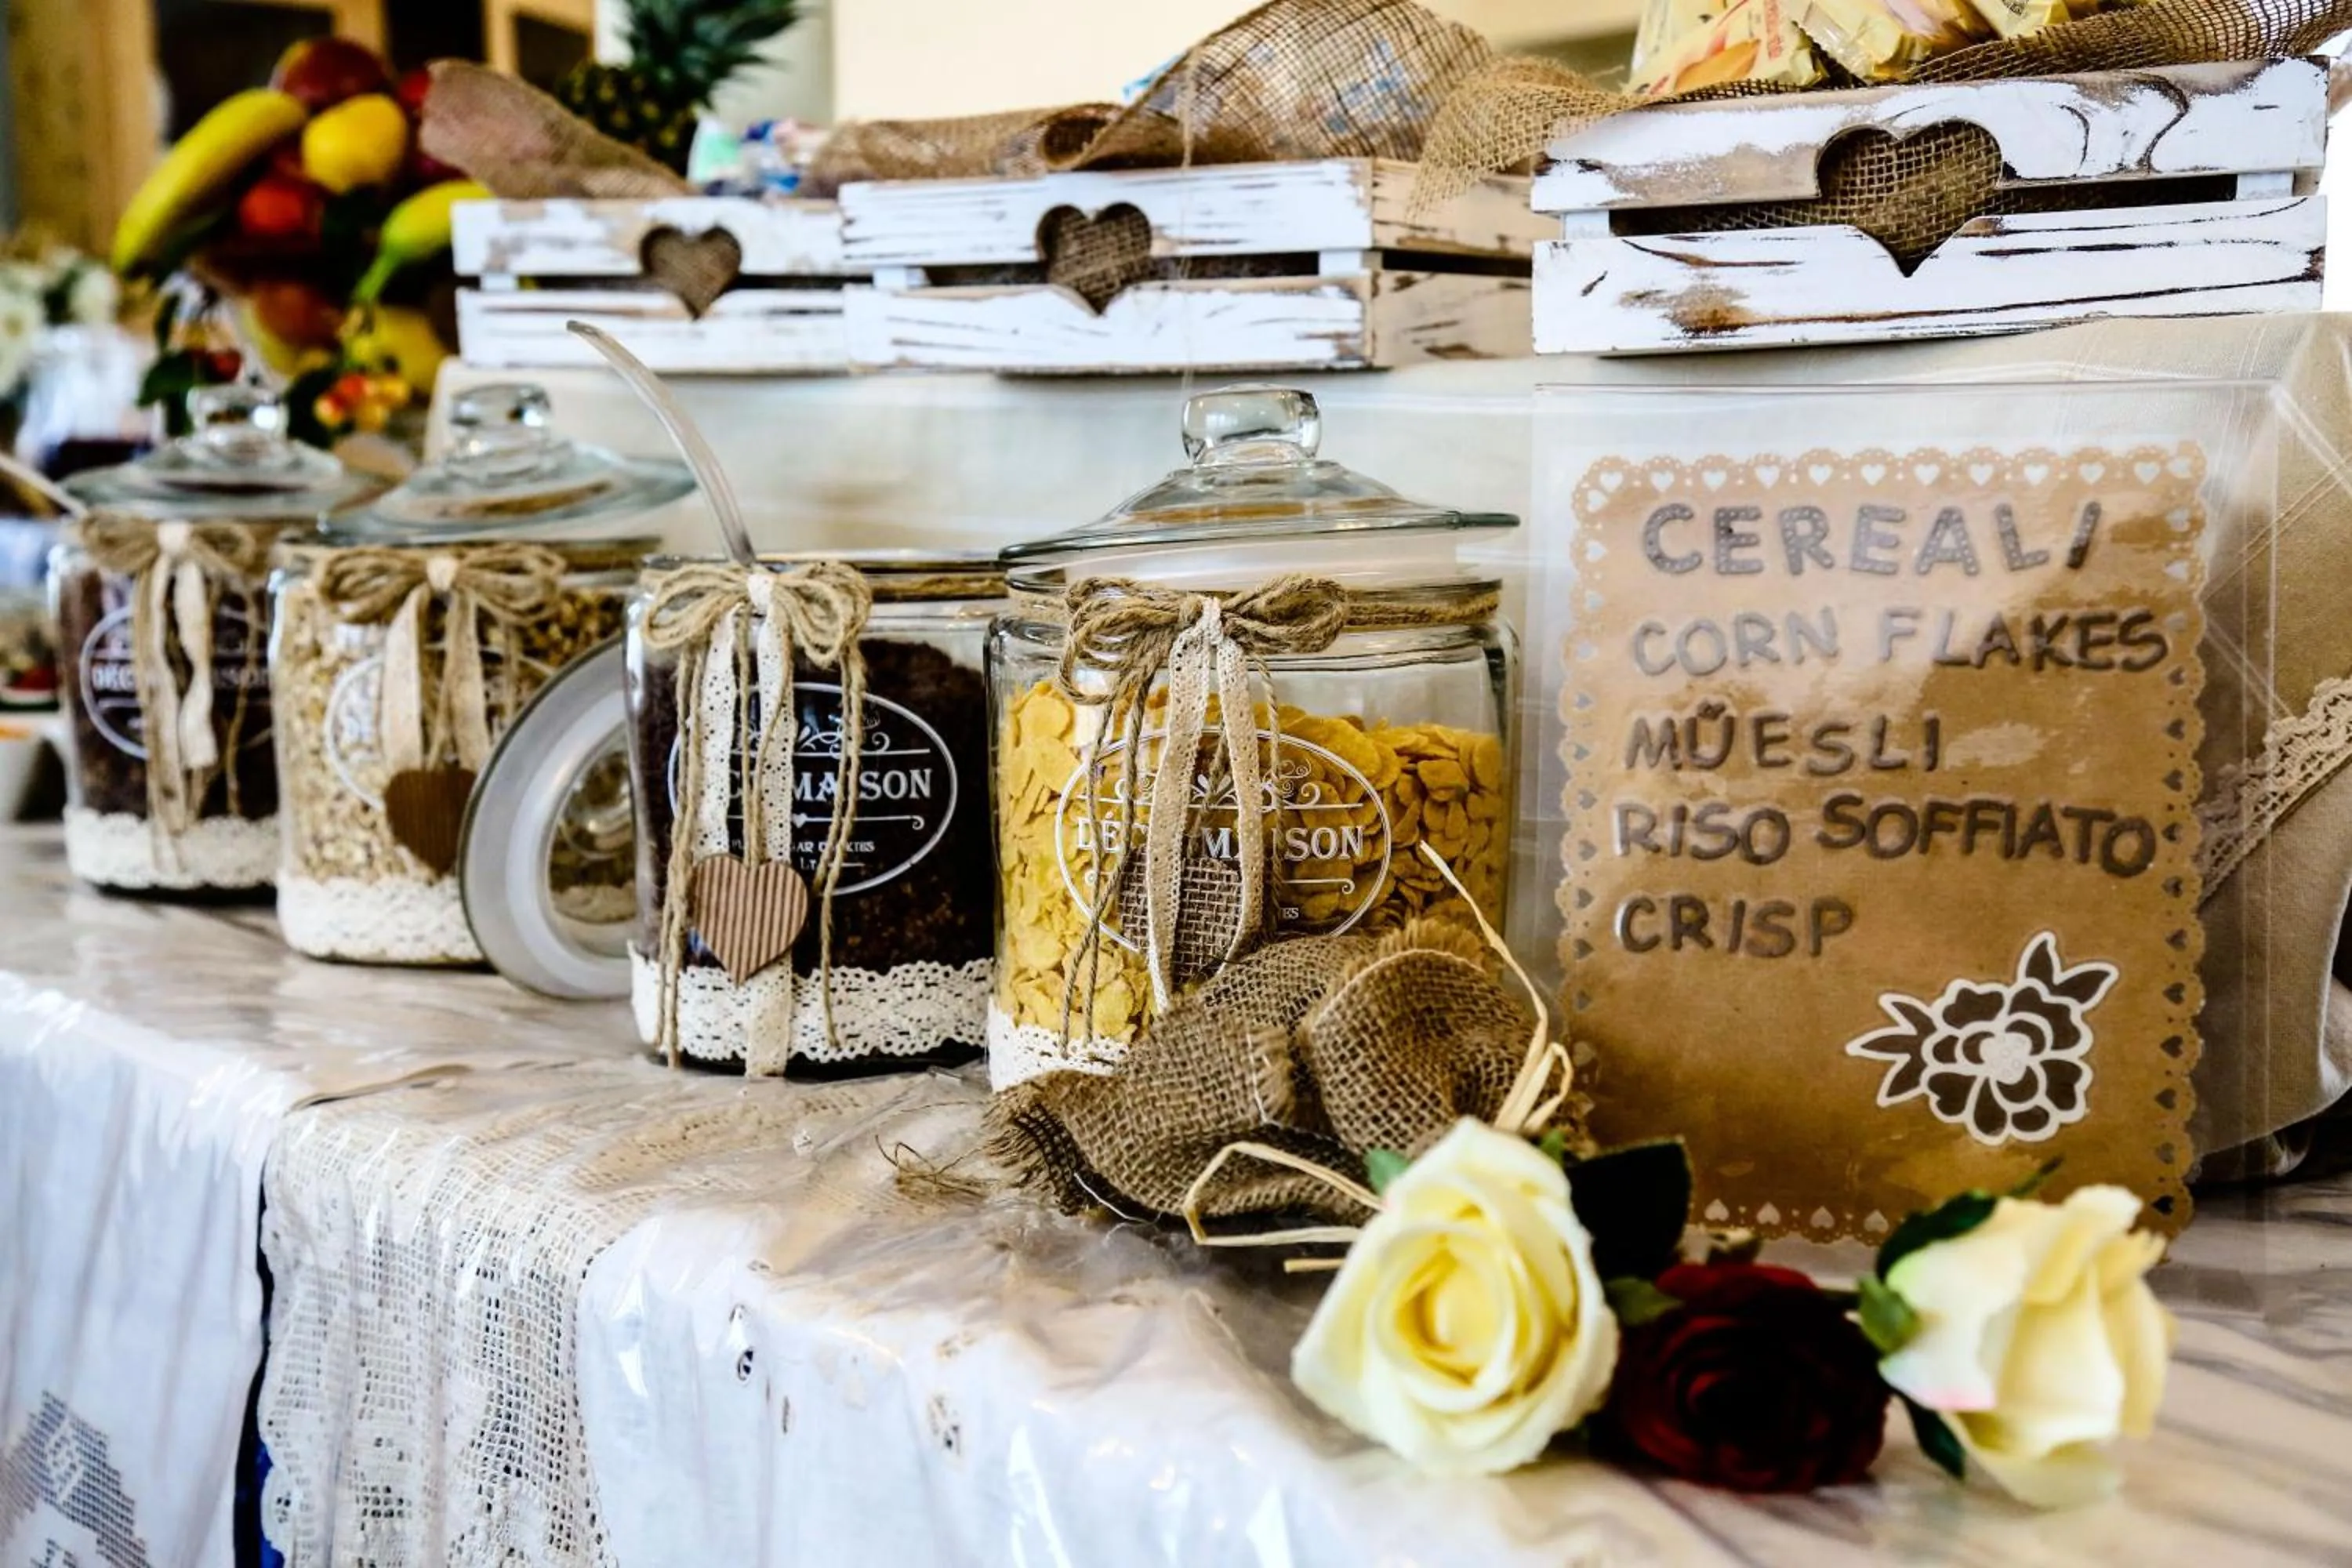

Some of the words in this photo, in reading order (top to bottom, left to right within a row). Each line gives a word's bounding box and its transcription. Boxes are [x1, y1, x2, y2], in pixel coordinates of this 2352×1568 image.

[1643, 502, 2100, 575] CEREALI
[1632, 606, 1838, 676] CORN
[1882, 606, 2168, 672] FLAKES
[792, 768, 932, 801] MASON
[1616, 800, 1791, 865] RISO
[1817, 793, 2157, 877] SOFFIATO
[1617, 894, 1853, 958] CRISP
